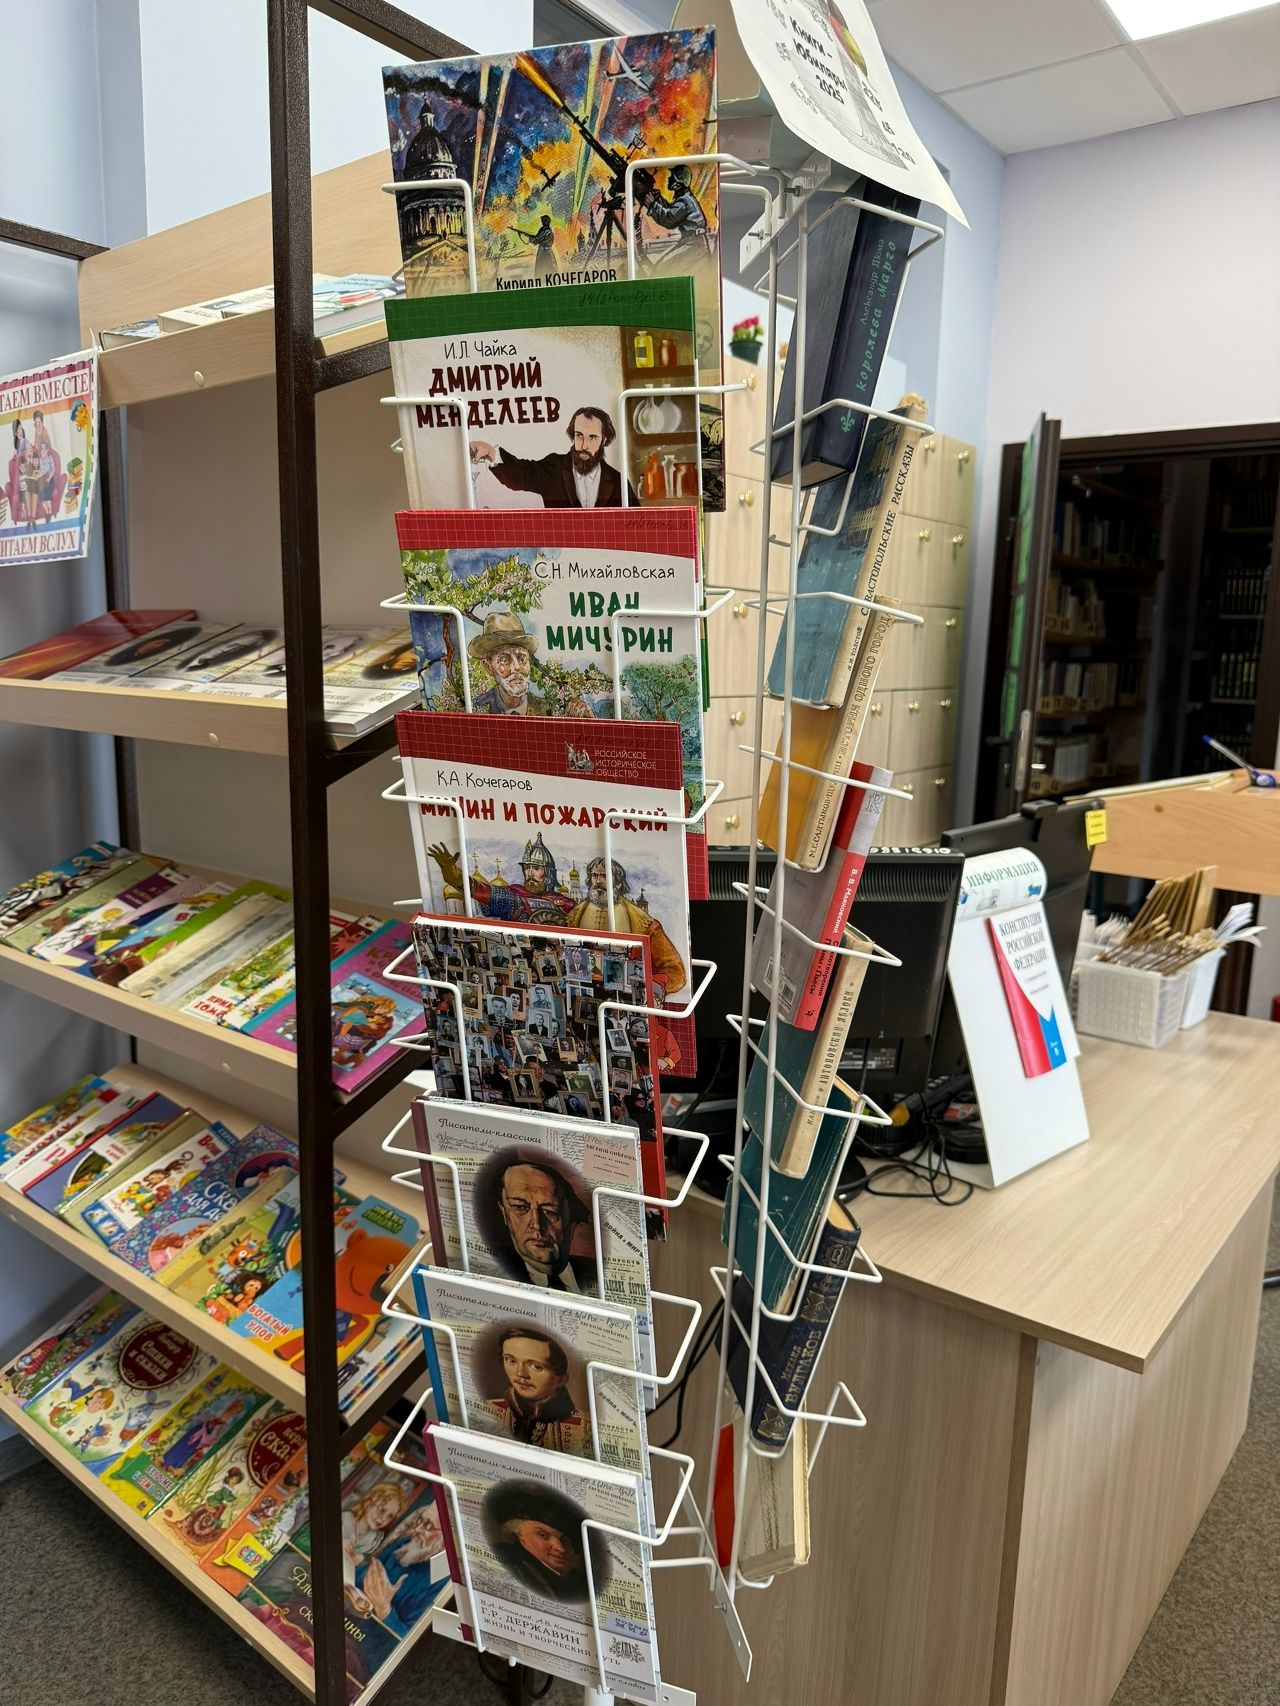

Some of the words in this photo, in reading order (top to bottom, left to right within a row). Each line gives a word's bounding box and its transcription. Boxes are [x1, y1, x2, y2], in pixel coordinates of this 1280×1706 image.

[789, 16, 826, 56] Книги
[816, 75, 845, 105] 2025
[545, 268, 617, 287] КОЧЕГАРОВ
[858, 270, 879, 325] Александр
[871, 238, 885, 268] Дюма
[444, 340, 471, 360] И.Л.
[474, 340, 517, 358] Чайка
[34, 372, 89, 404] ВМЕСТЕ
[429, 356, 543, 397] ДМИТРИЙ
[415, 395, 561, 430] МЕНДЕЛЕЕВ
[39, 530, 77, 552] ВСЛУХ
[861, 510, 897, 617] СВАСТОПОЛЬСКИЕ
[890, 444, 916, 506] РАССКАЗЫ
[534, 561, 565, 580] С.Н.
[568, 562, 675, 579] Михайловская
[569, 591, 640, 618] ИВАН
[546, 625, 673, 653] МИЧУРИН
[854, 655, 877, 703] ОДНОГО
[594, 749, 648, 760] РОССИЙСКОЕ
[595, 759, 657, 770] ИСТОРИЧЕСКОЕ
[437, 769, 464, 787] К.А.
[465, 772, 533, 791] Кочегаров
[596, 768, 639, 778] ОБЩЕСТВО
[502, 801, 518, 822] И
[523, 802, 669, 833] ПОЖАРСКИЙ
[965, 861, 1040, 888] ИНФОРМАЦИЯ
[832, 887, 853, 935] Маяковский
[999, 911, 1043, 938] КОНСТИТУЦИЯ
[1005, 927, 1045, 955] РОССИЙСКОЙ
[1013, 947, 1048, 972] ФЕДЕРАЦИИ
[809, 970, 822, 995] Пьесы
[819, 1026, 844, 1085] АНТОНОВСКИЕ
[438, 1117, 542, 1144] Писатели-классики
[436, 1287, 537, 1318] Писатели-классики
[245, 1319, 274, 1343] УЛОВ
[248, 1303, 292, 1337] БОГАТЫЙ
[785, 1330, 823, 1404] БУЛГАКОВ
[447, 1446, 546, 1480] Писатели-классики
[481, 1606, 502, 1620] Г.Р.
[505, 1615, 581, 1646] ДЕРЖАВИН
[483, 1617, 516, 1633] ЖИЗНЬ
[528, 1632, 592, 1657] ТВОРЧЕСКИЙ
